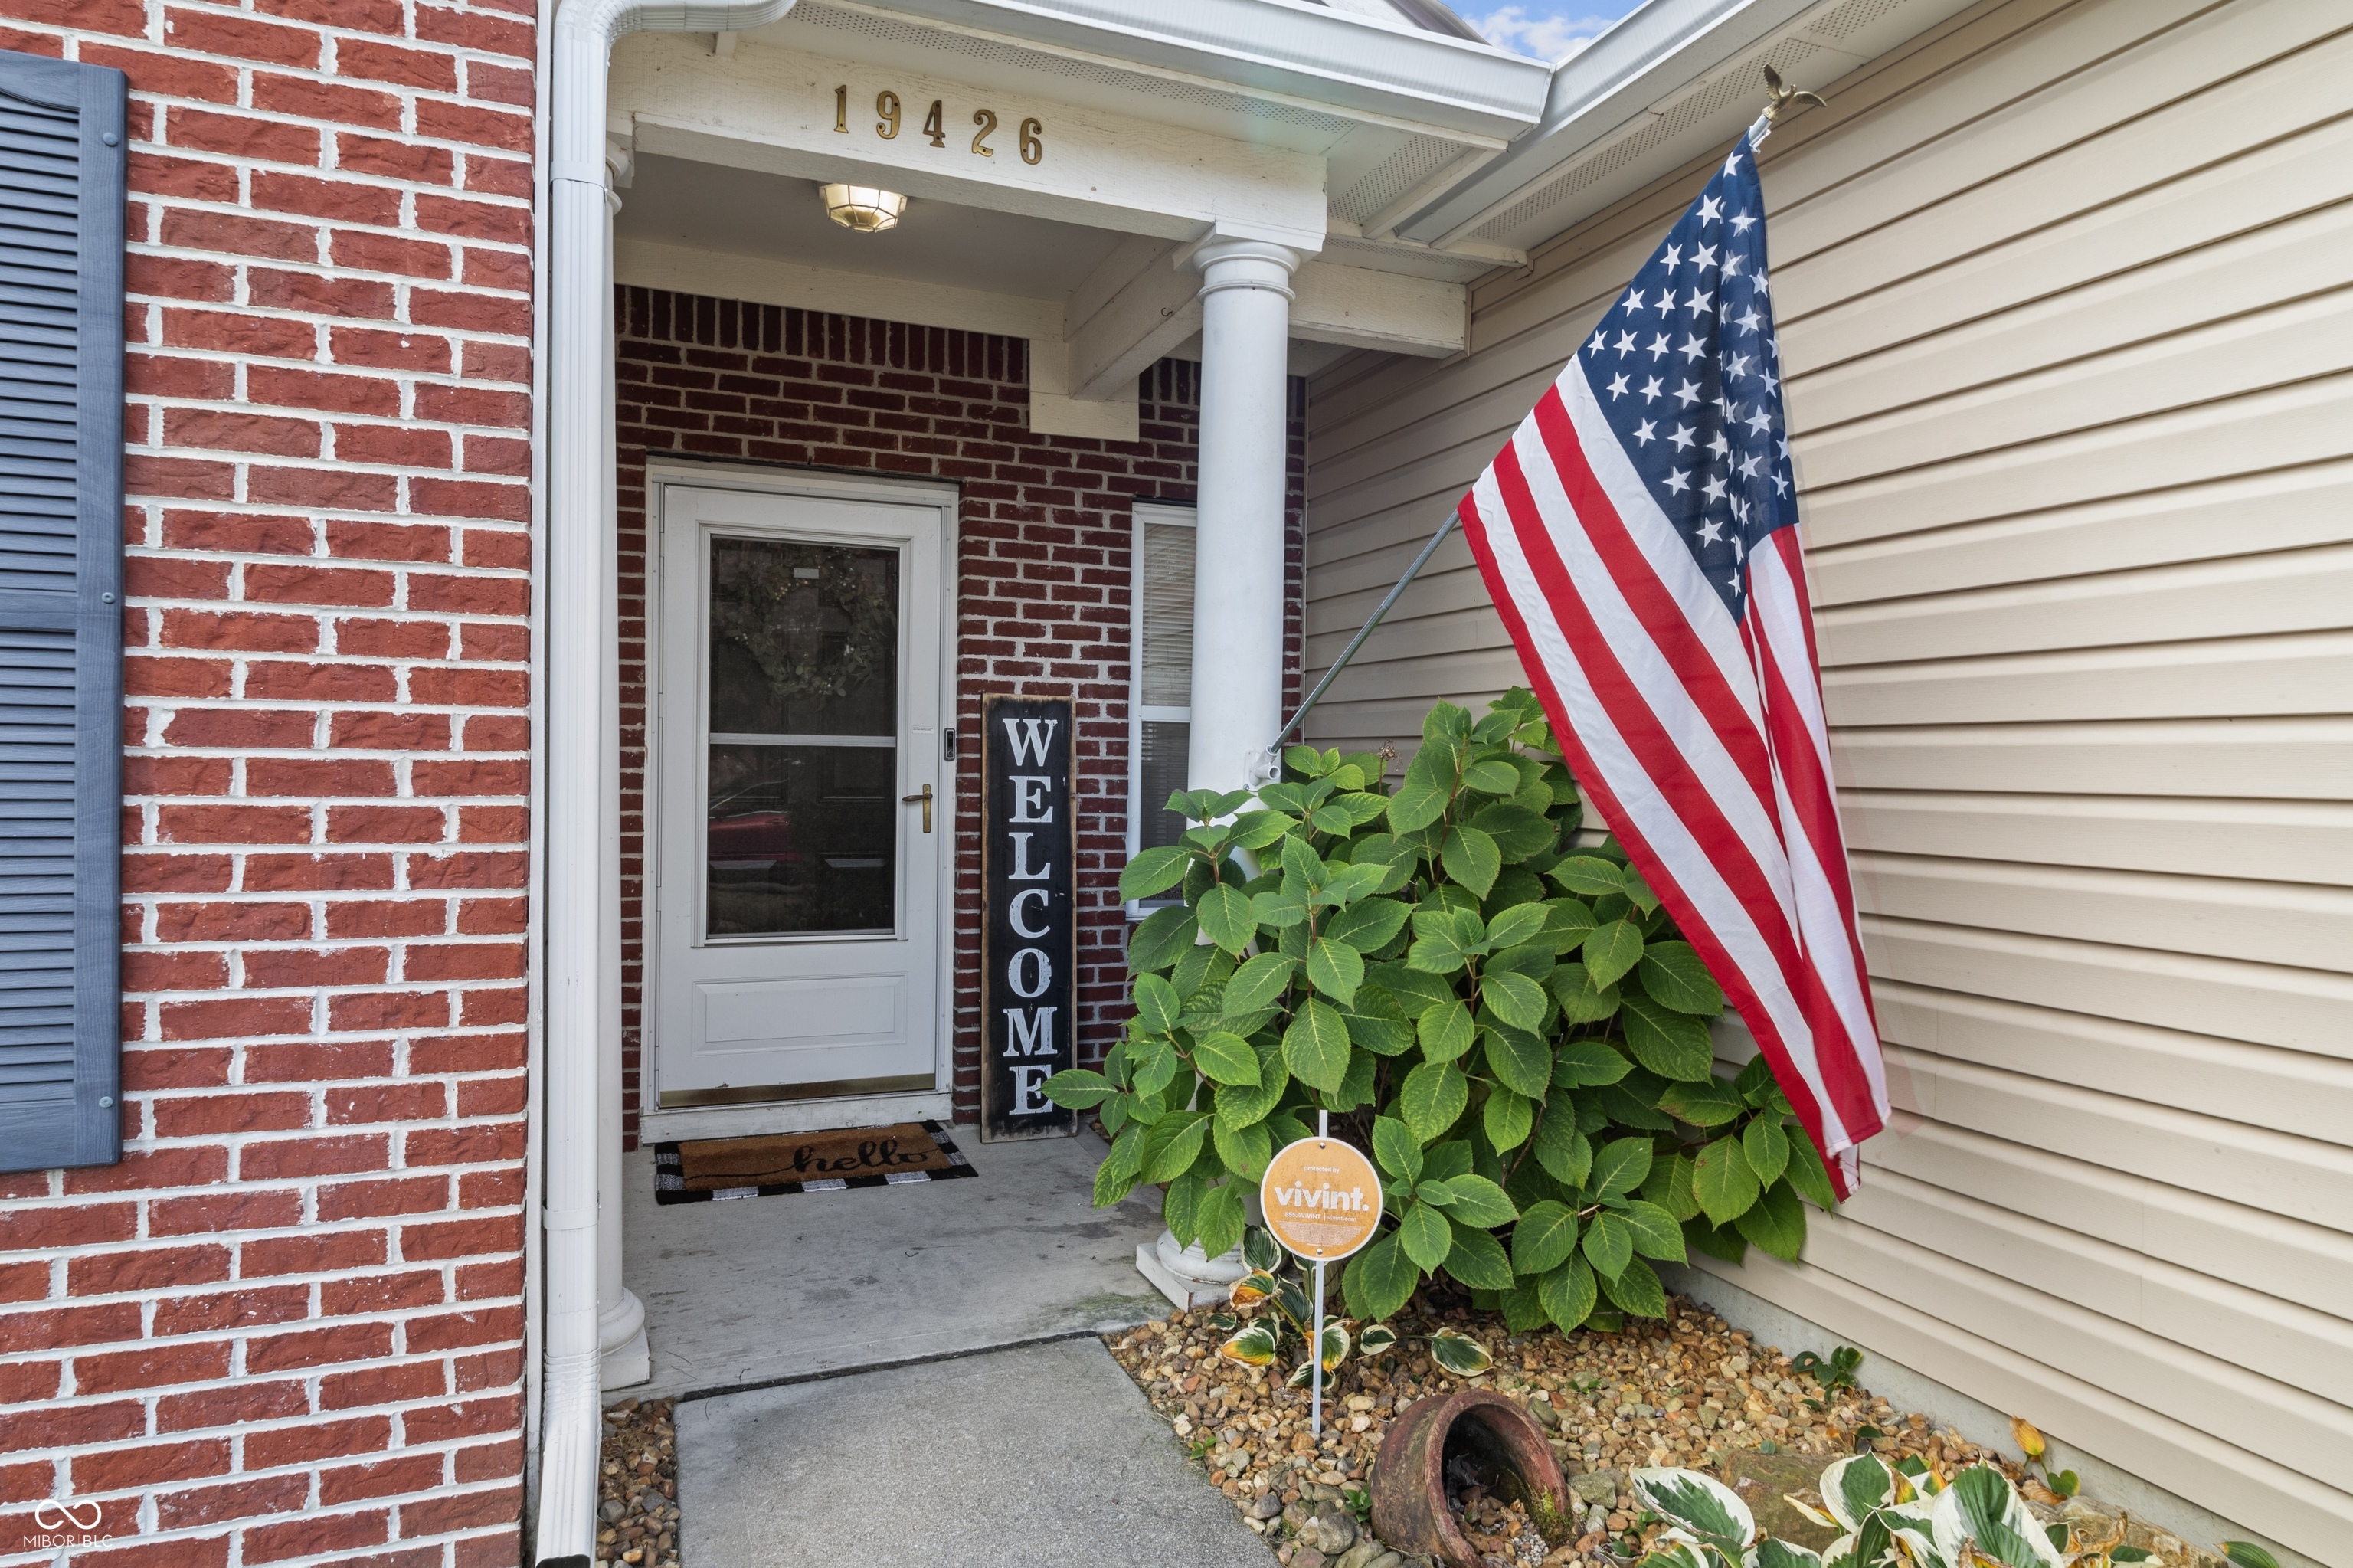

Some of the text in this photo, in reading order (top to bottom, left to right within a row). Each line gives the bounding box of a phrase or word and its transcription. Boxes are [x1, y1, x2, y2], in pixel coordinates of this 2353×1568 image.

[833, 84, 1042, 165] 19426
[1003, 717, 1058, 1115] WELCOME
[792, 1138, 939, 1173] hello
[1304, 1165, 1331, 1174] protected
[1284, 1211, 1321, 1219] 855.4VIVINT
